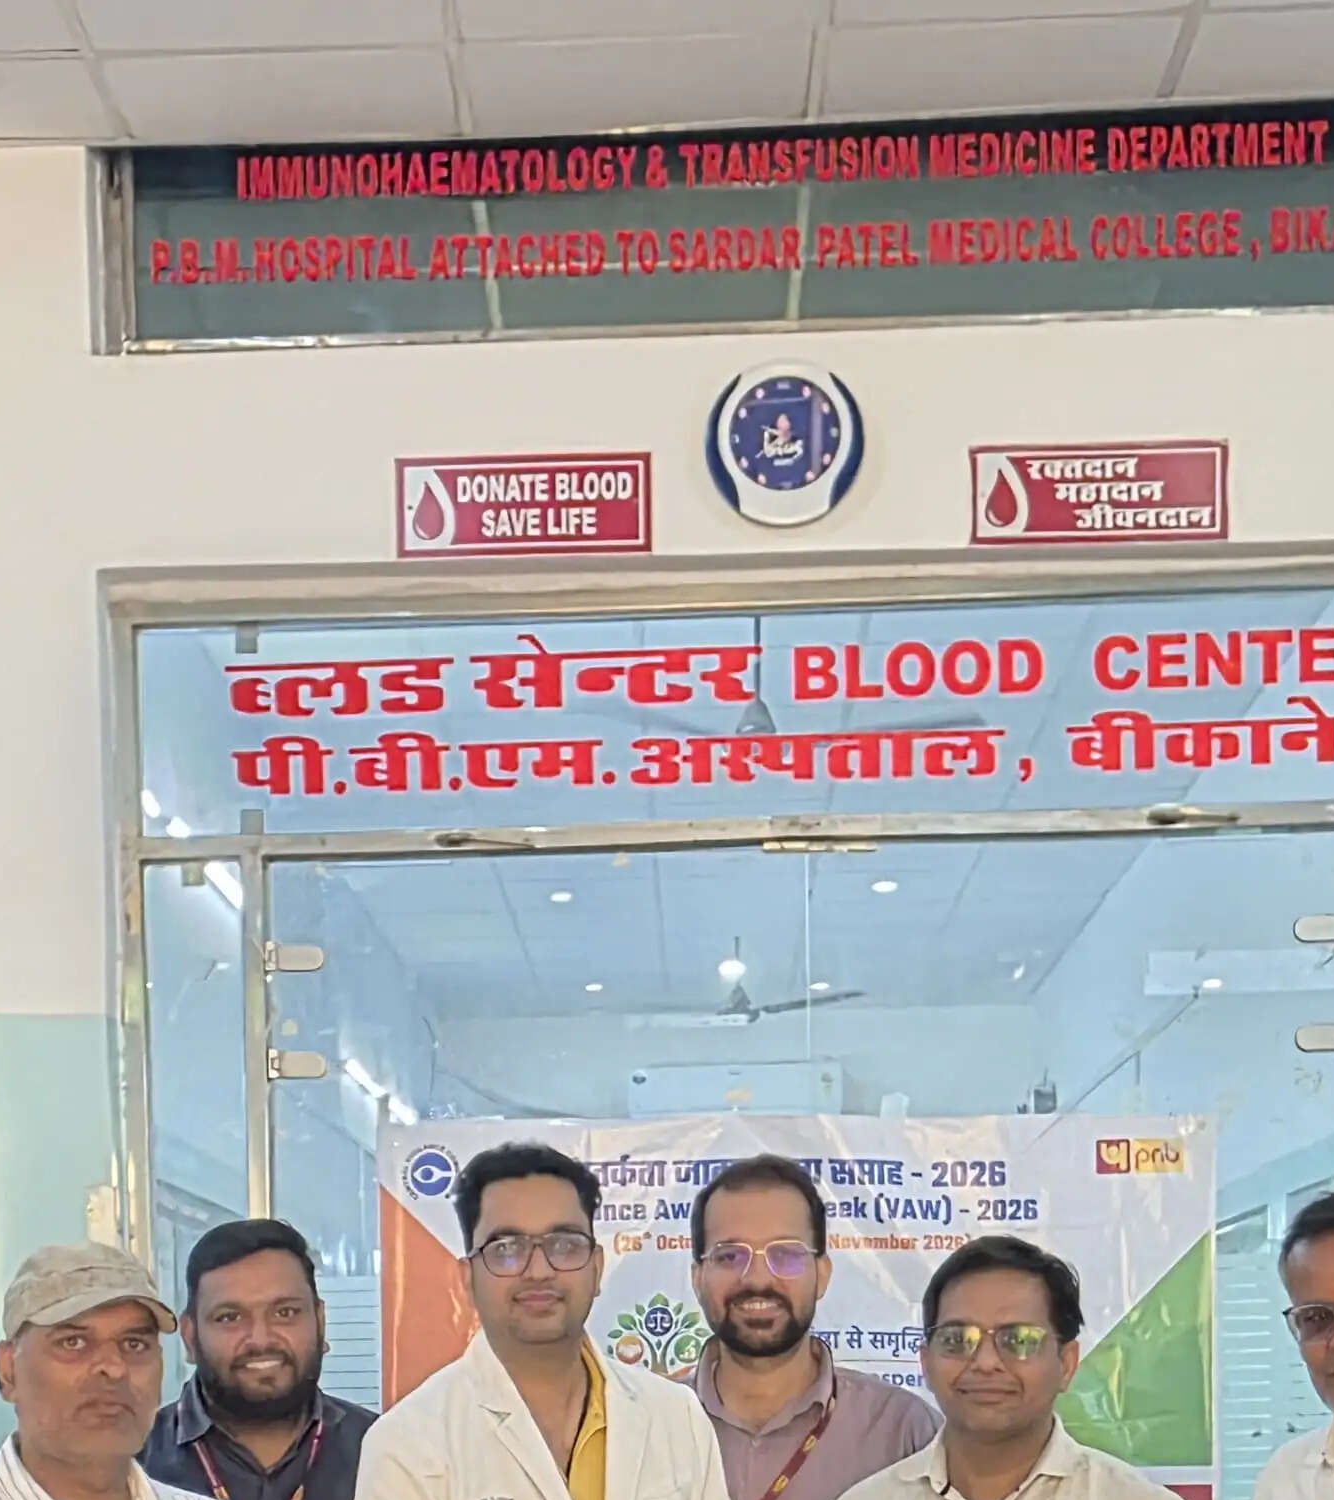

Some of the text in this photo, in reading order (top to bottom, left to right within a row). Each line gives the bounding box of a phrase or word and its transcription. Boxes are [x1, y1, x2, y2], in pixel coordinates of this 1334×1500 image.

[236, 120, 1329, 201] IMMUNOHAEMATOLOGY & TRANSFUSION MEDICINE DEPARTMENT
[428, 231, 606, 281] ATTACHED
[615, 231, 658, 276] TO
[668, 226, 803, 273] SARDAR
[817, 223, 918, 269] PATEL
[927, 216, 1079, 265] MEDICAL
[457, 471, 633, 503] DONATE BLOOD
[1054, 481, 1164, 503] महादान
[481, 507, 597, 537] SAVE LIFE
[1073, 504, 1213, 529] जीवनदान
[224, 656, 454, 717] ब्लड
[469, 634, 762, 709] सेन्टर
[792, 638, 1044, 702] BLOOD
[1136, 1141, 1180, 1169] pnb
[931, 1160, 1006, 1187] 2026
[826, 1196, 867, 1218] eek
[874, 1193, 952, 1225] (VAW)
[977, 1199, 1038, 1221] 2026
[845, 1325, 864, 1349] से
